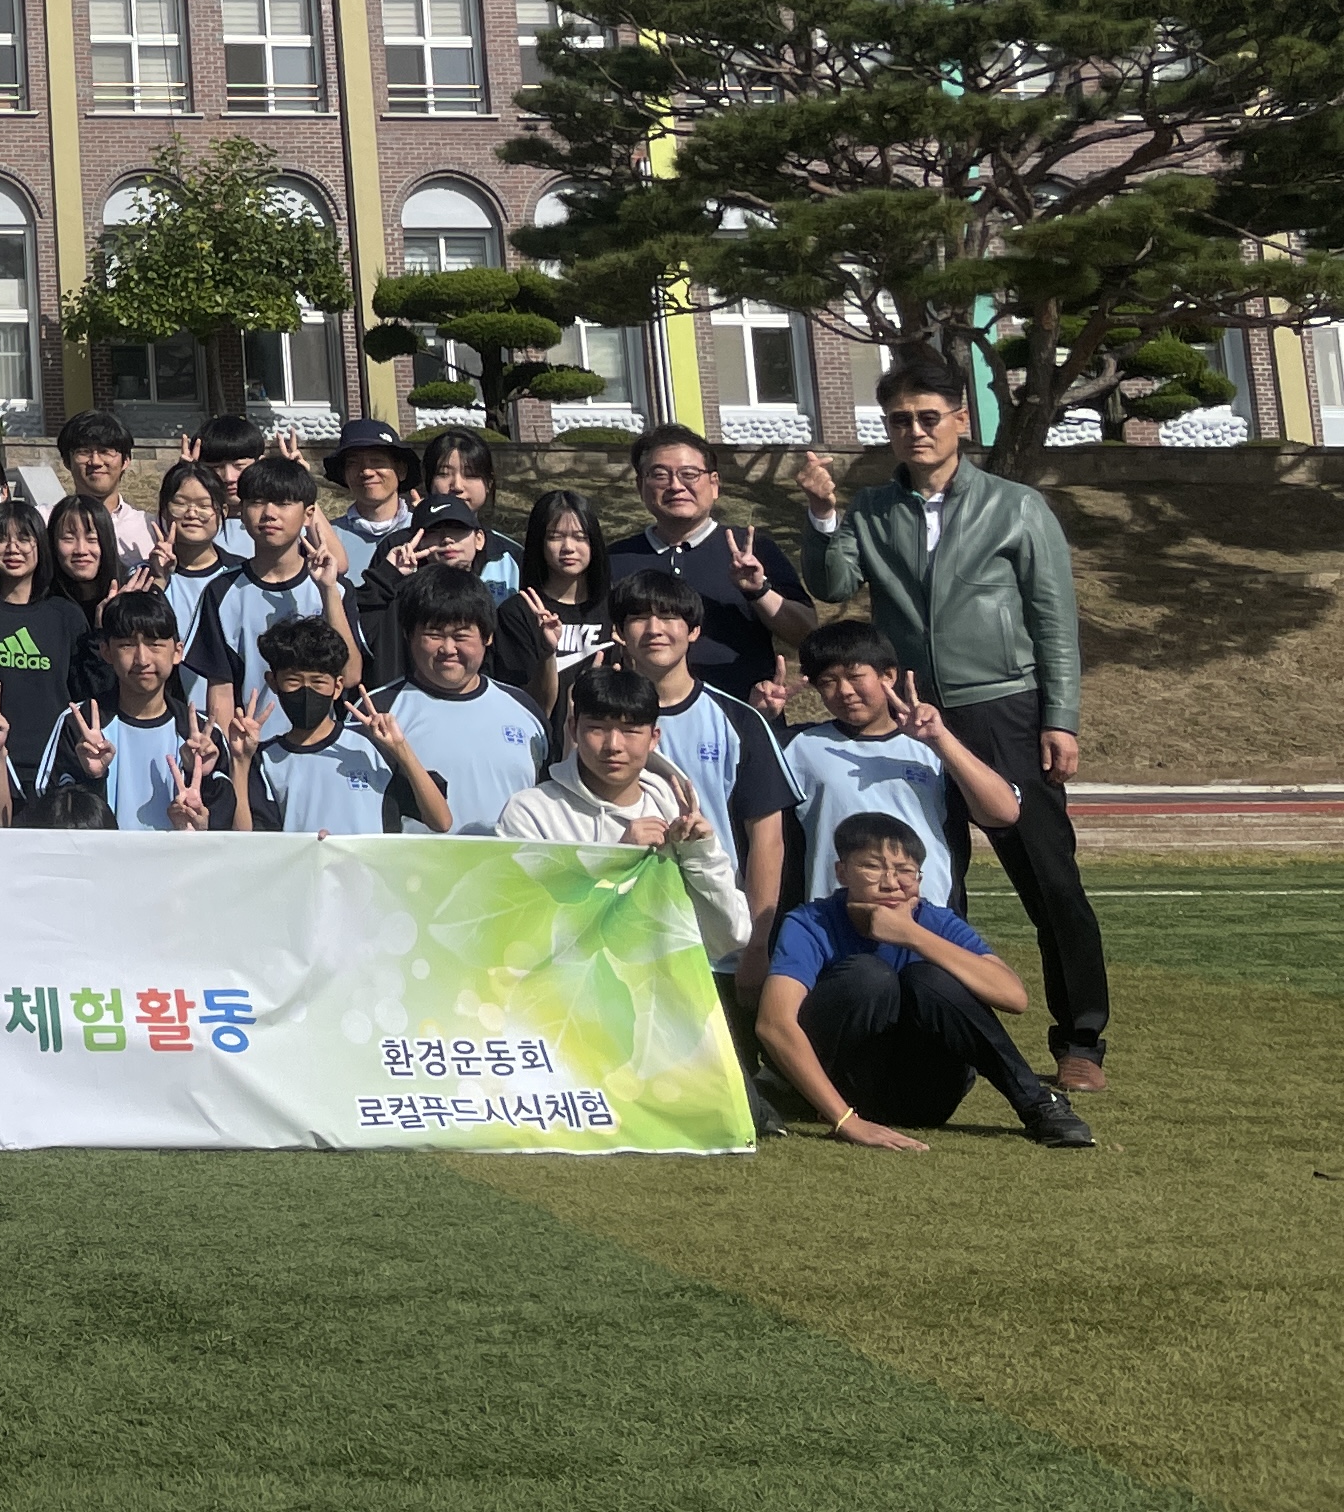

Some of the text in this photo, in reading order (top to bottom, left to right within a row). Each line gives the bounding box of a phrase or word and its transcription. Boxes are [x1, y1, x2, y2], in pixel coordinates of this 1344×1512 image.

[6, 987, 257, 1054] 체험활동
[383, 1039, 554, 1076] 환경운동회
[359, 1092, 613, 1130] 로컬푸드시식체험
